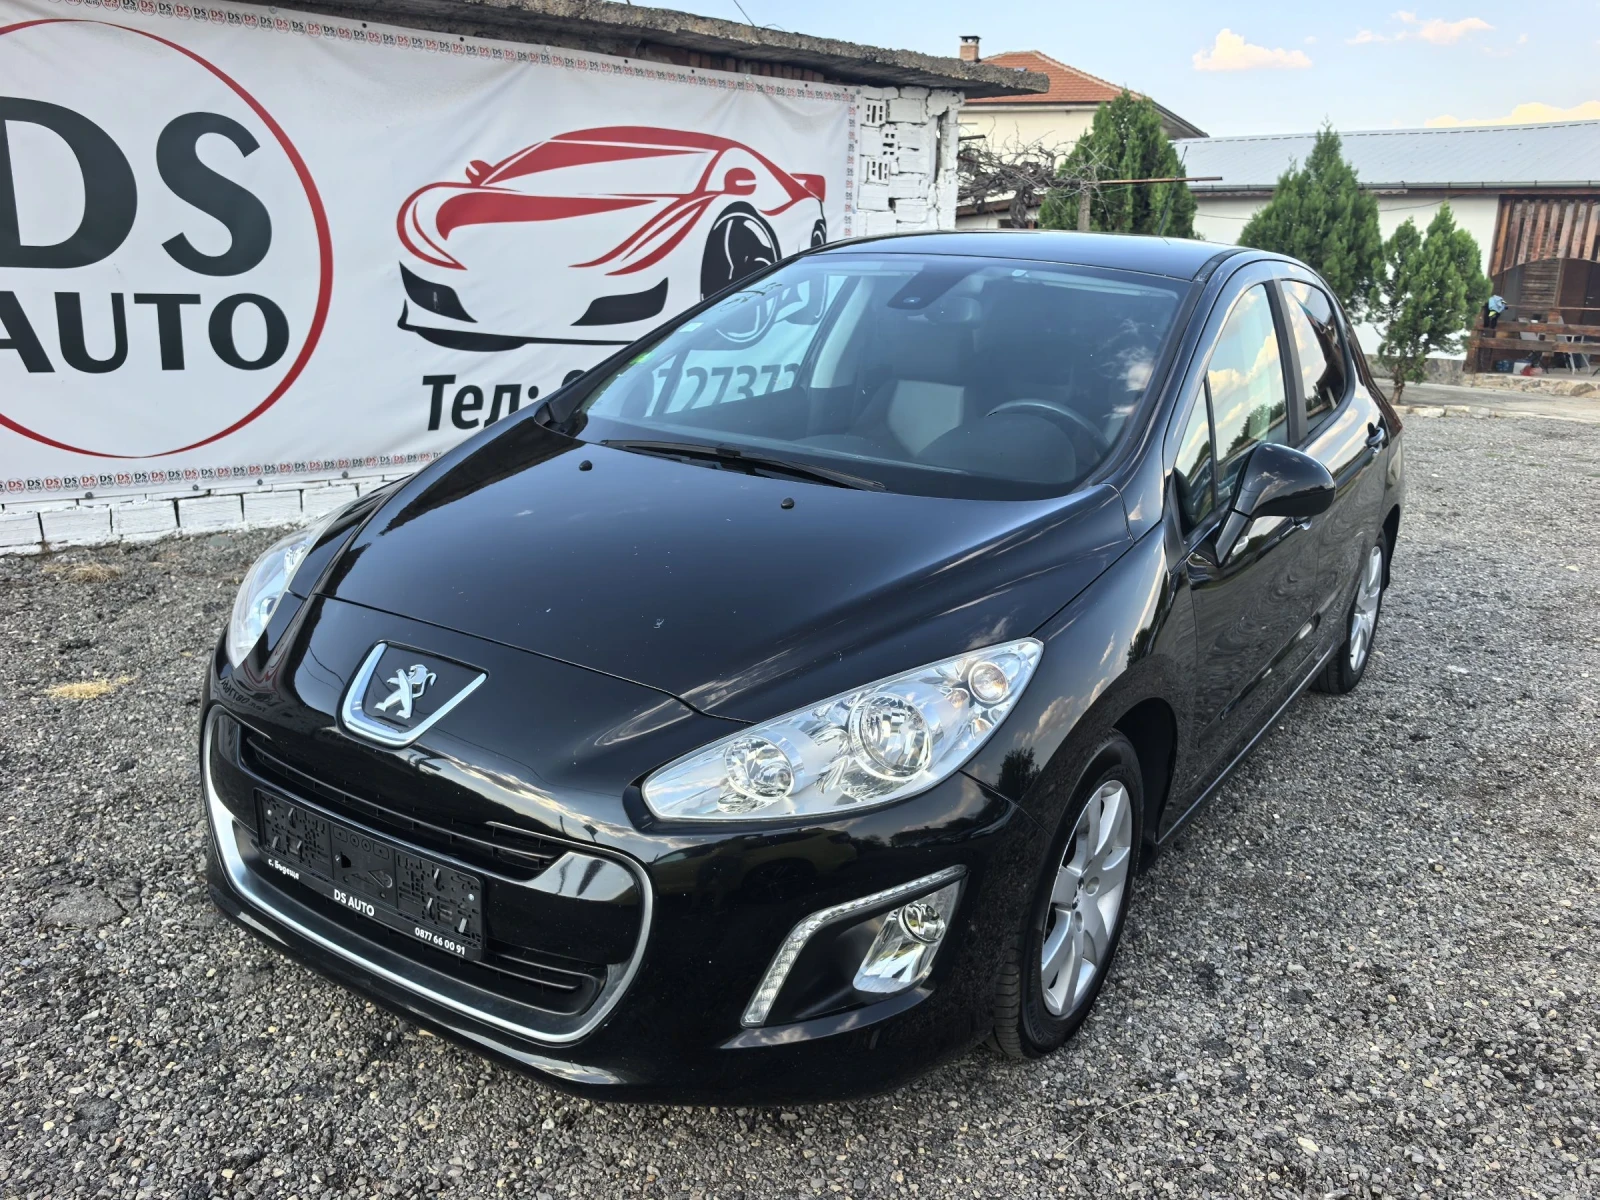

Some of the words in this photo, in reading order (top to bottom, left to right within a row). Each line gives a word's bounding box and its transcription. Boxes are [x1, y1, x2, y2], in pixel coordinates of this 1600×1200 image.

[0, 94, 272, 277] DS
[334, 888, 347, 904] DS
[348, 896, 374, 916] AUTO
[414, 927, 432, 941] 0877
[433, 935, 443, 946] 66
[444, 940, 455, 950] 00
[456, 944, 465, 956] 91
